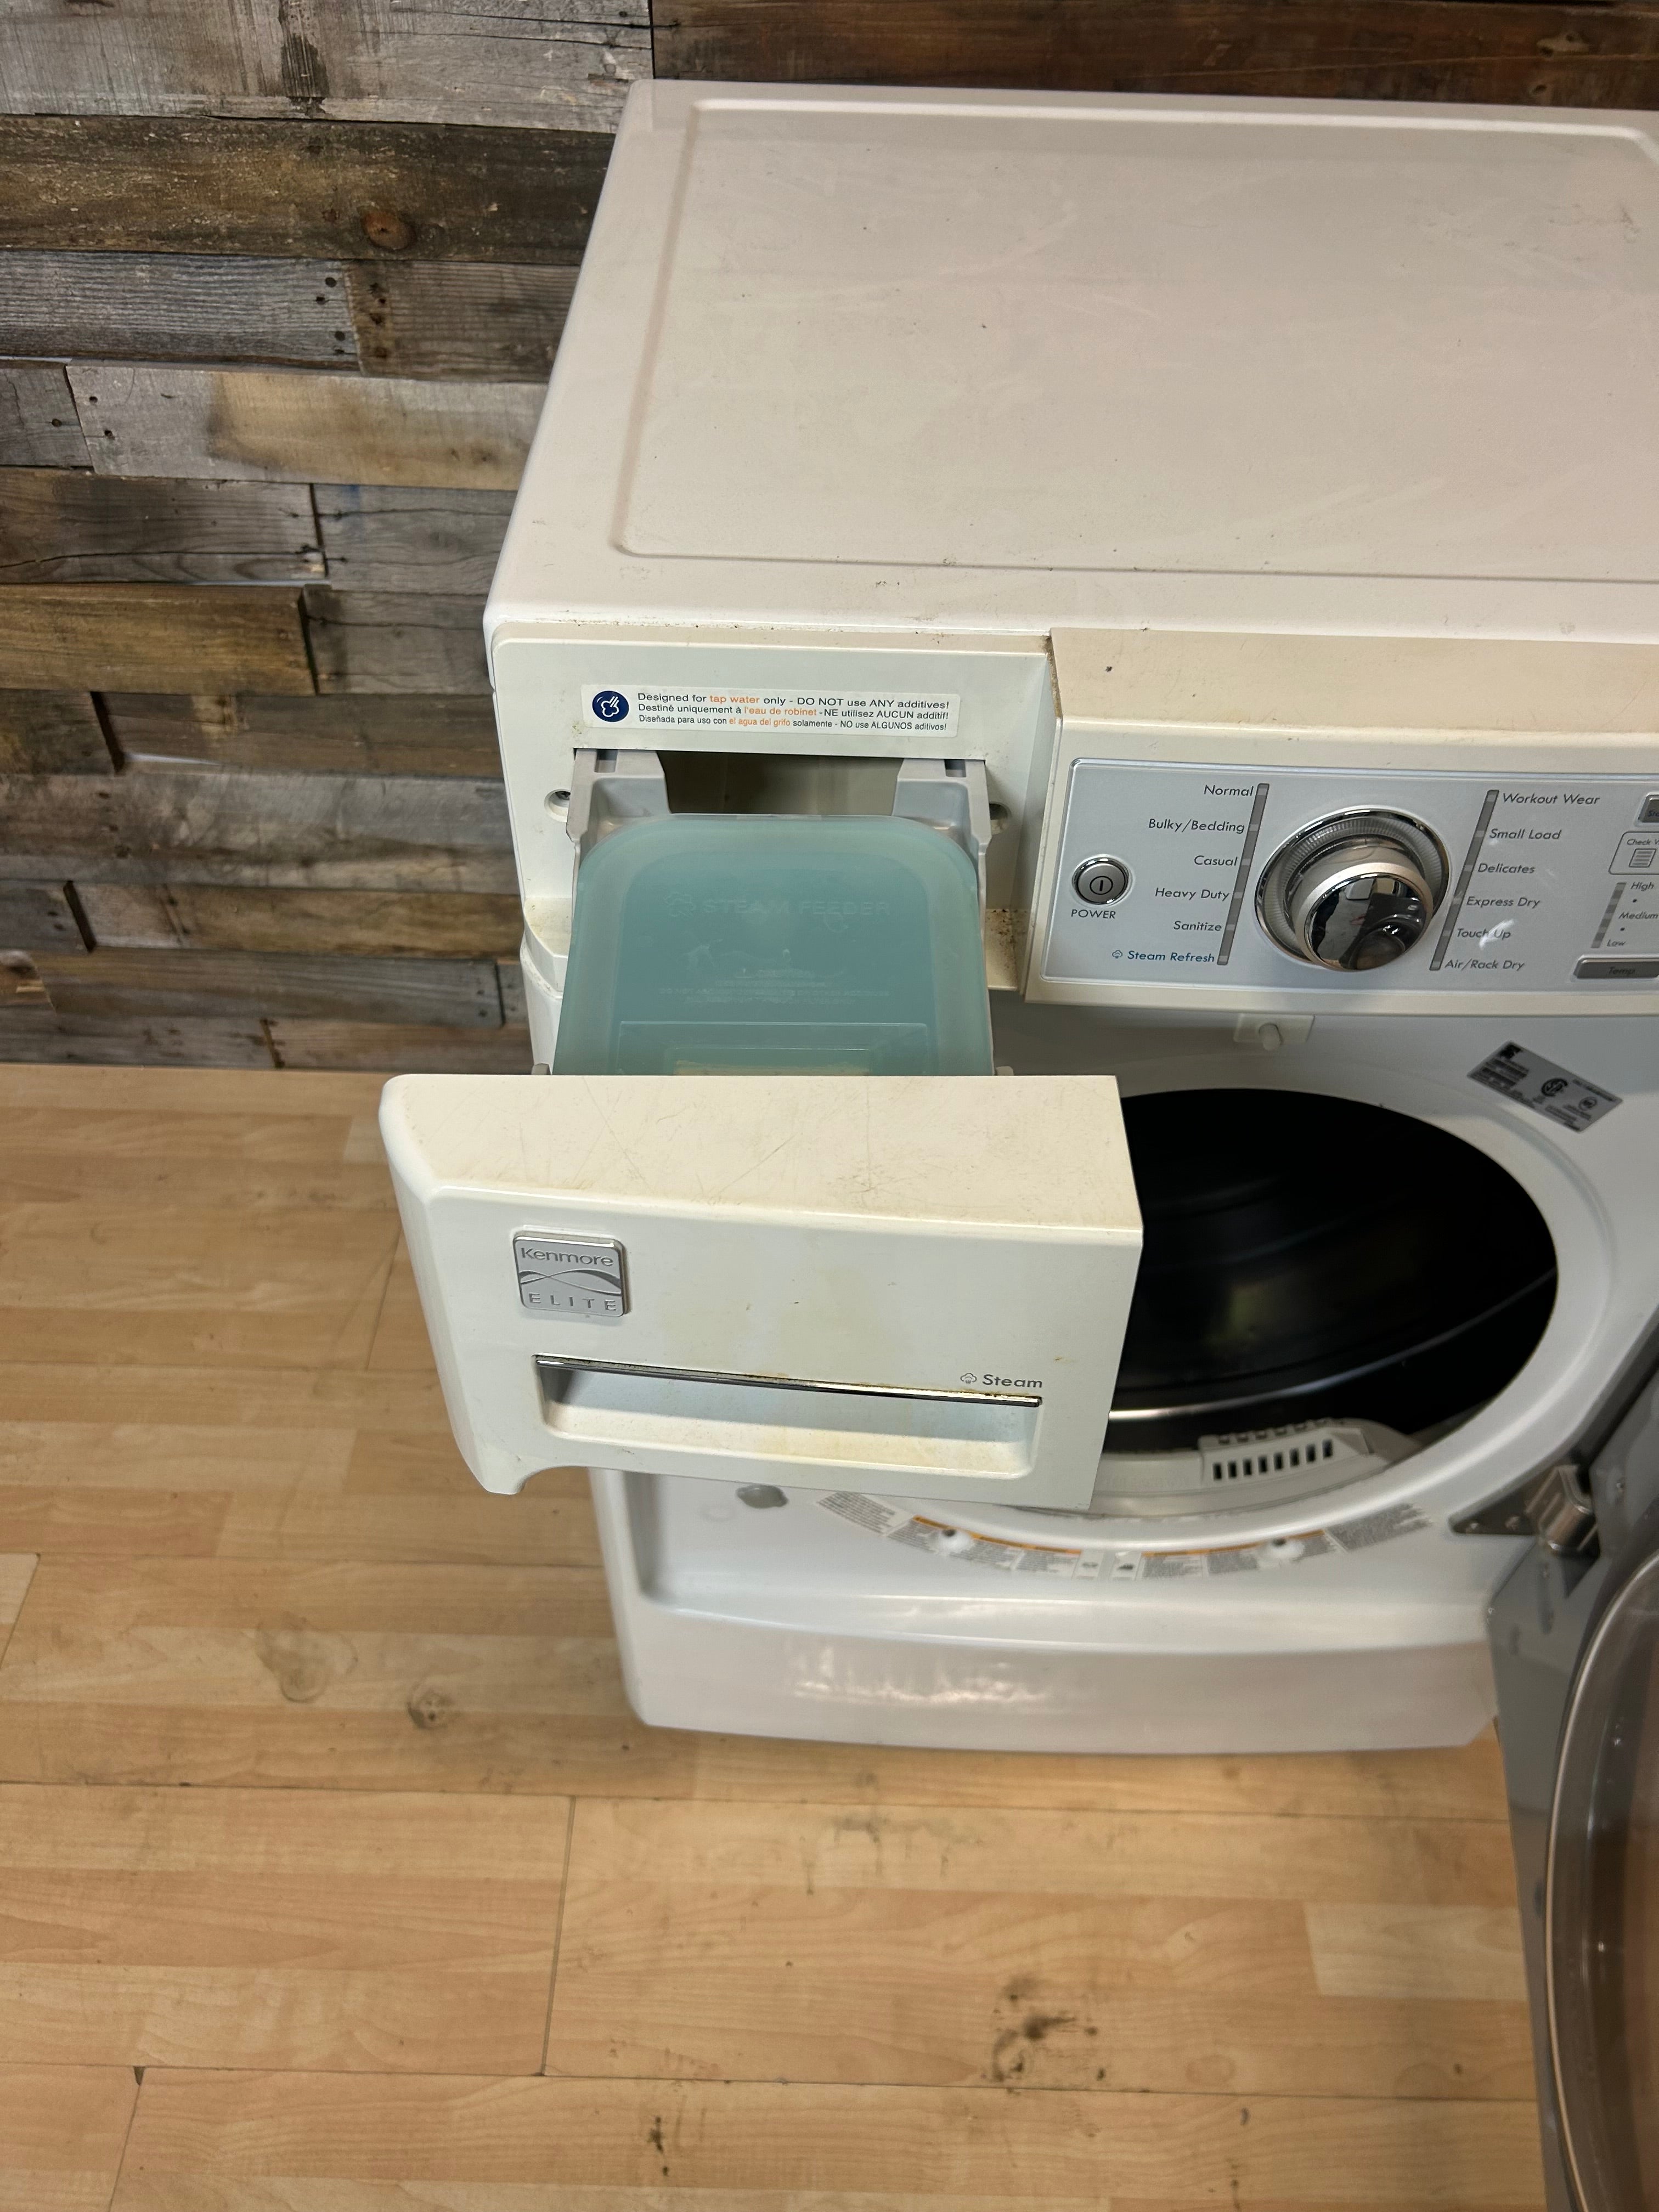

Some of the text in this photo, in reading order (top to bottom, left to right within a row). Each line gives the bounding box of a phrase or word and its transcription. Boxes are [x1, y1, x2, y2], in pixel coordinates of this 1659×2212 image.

[637, 693, 689, 702] Designed
[709, 695, 726, 704] tap
[763, 697, 786, 706] only
[819, 698, 843, 706] NOT
[898, 701, 949, 709] additives!
[639, 703, 674, 712] Destiné
[678, 705, 733, 714] uniquement
[876, 710, 914, 719] AUCUN
[678, 716, 695, 725] para
[774, 719, 791, 727] grifo
[871, 721, 912, 730] ALGUNOS
[1204, 785, 1254, 797] Normal
[1503, 793, 1600, 805] Workout Wear
[1148, 818, 1245, 834] Bulky/Bedding
[1489, 829, 1562, 840] Small Load
[1194, 855, 1238, 867] Casual
[1477, 864, 1536, 874] Delicates
[1631, 882, 1654, 891] High
[1155, 888, 1230, 901] Heavy Duty
[1466, 896, 1540, 909] Express Dry
[1071, 909, 1116, 919] POWER
[1173, 921, 1222, 932] Sanitize
[1457, 928, 1511, 940] Touch Up
[1127, 951, 1215, 963] Steam Refresh
[1444, 960, 1525, 972] Air/Rack Dry
[1608, 967, 1635, 976] Temp
[521, 1247, 614, 1266] Kenmore
[528, 1293, 617, 1311] ELITE
[982, 1374, 1042, 1388] Steam
